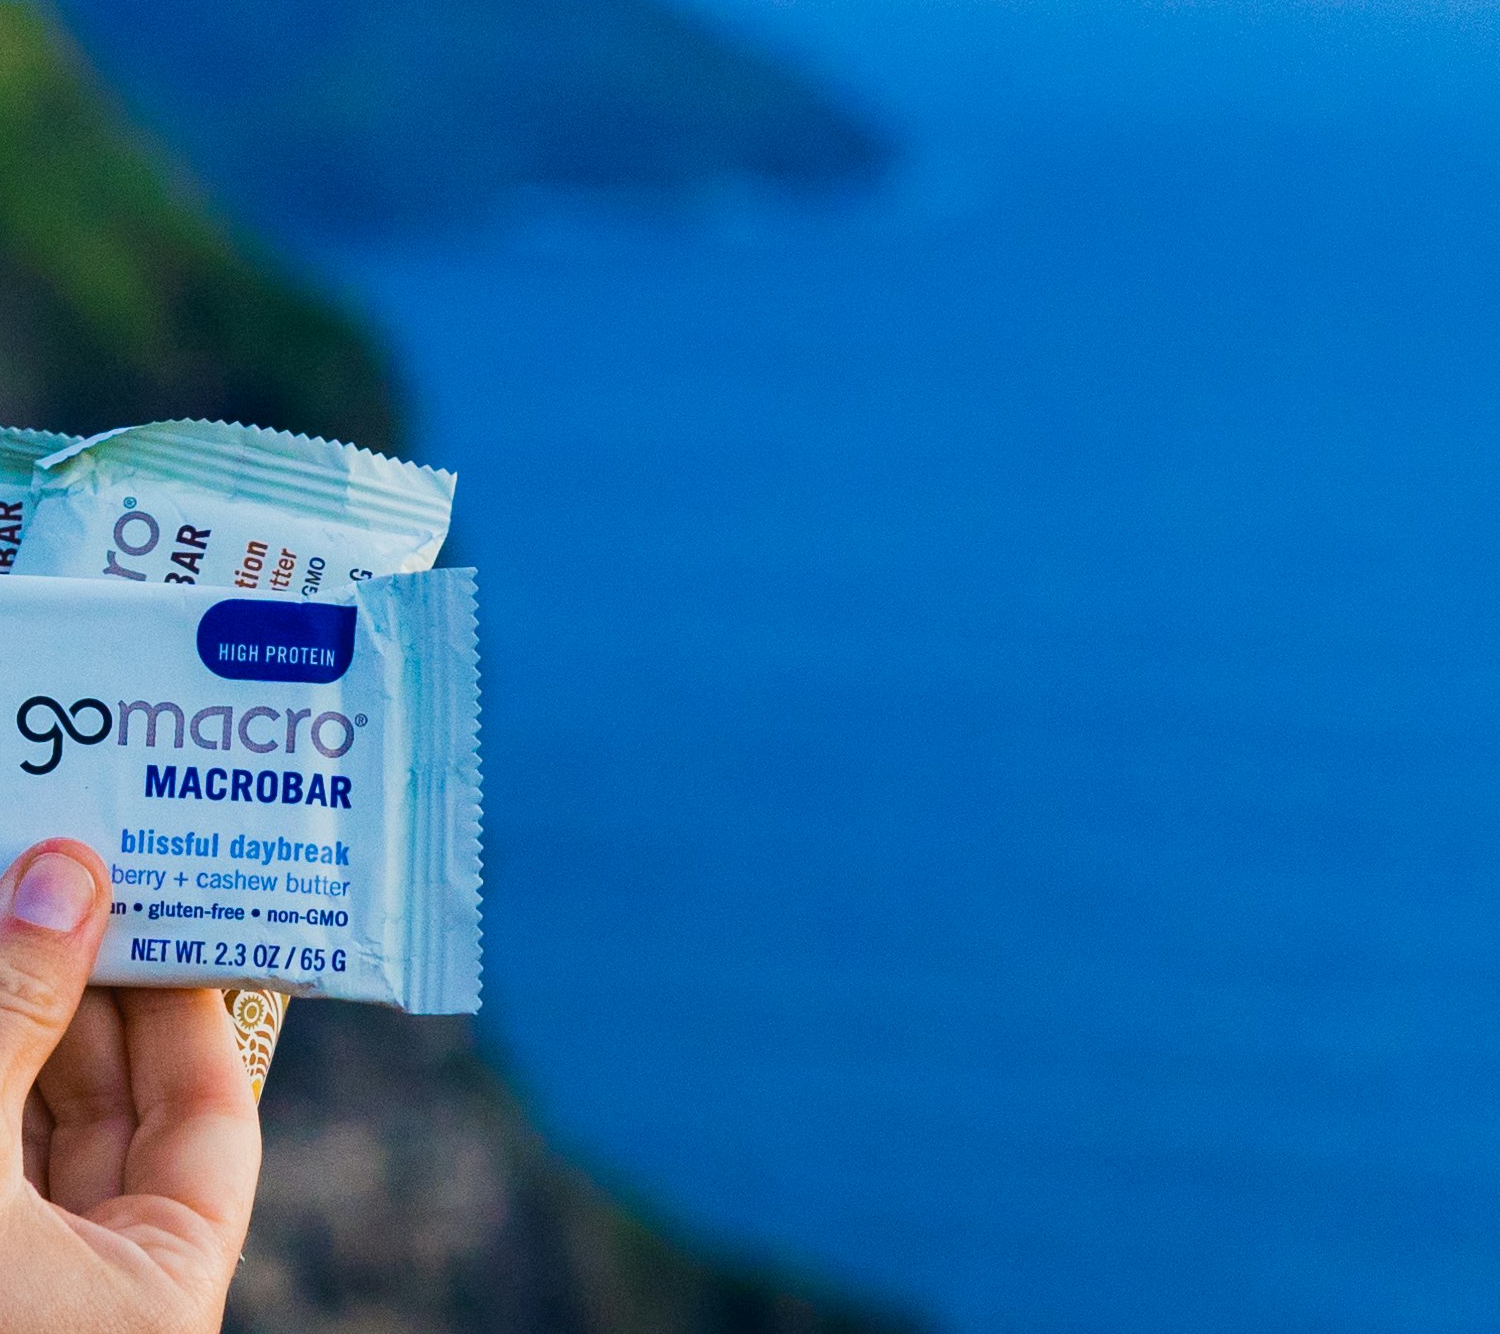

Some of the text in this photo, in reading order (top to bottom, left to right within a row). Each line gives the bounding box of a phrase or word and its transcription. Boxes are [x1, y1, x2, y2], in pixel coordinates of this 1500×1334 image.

[164, 524, 212, 585] BAR
[234, 540, 269, 589] tion
[269, 548, 297, 592] tter
[218, 643, 336, 668] HIGH PROTEIN
[145, 764, 353, 809] MACROBAR
[121, 828, 349, 866] blissful daybreak
[111, 864, 166, 890] berry
[196, 869, 278, 892] cashew
[286, 872, 350, 897] butter
[148, 901, 245, 920] gluten-free
[267, 908, 348, 927] non-GMO
[131, 938, 171, 963] NET
[176, 939, 208, 965] WT.
[214, 941, 247, 967] 2.3
[253, 944, 281, 969] OZ
[300, 948, 326, 972] 65
[331, 949, 347, 972] G
